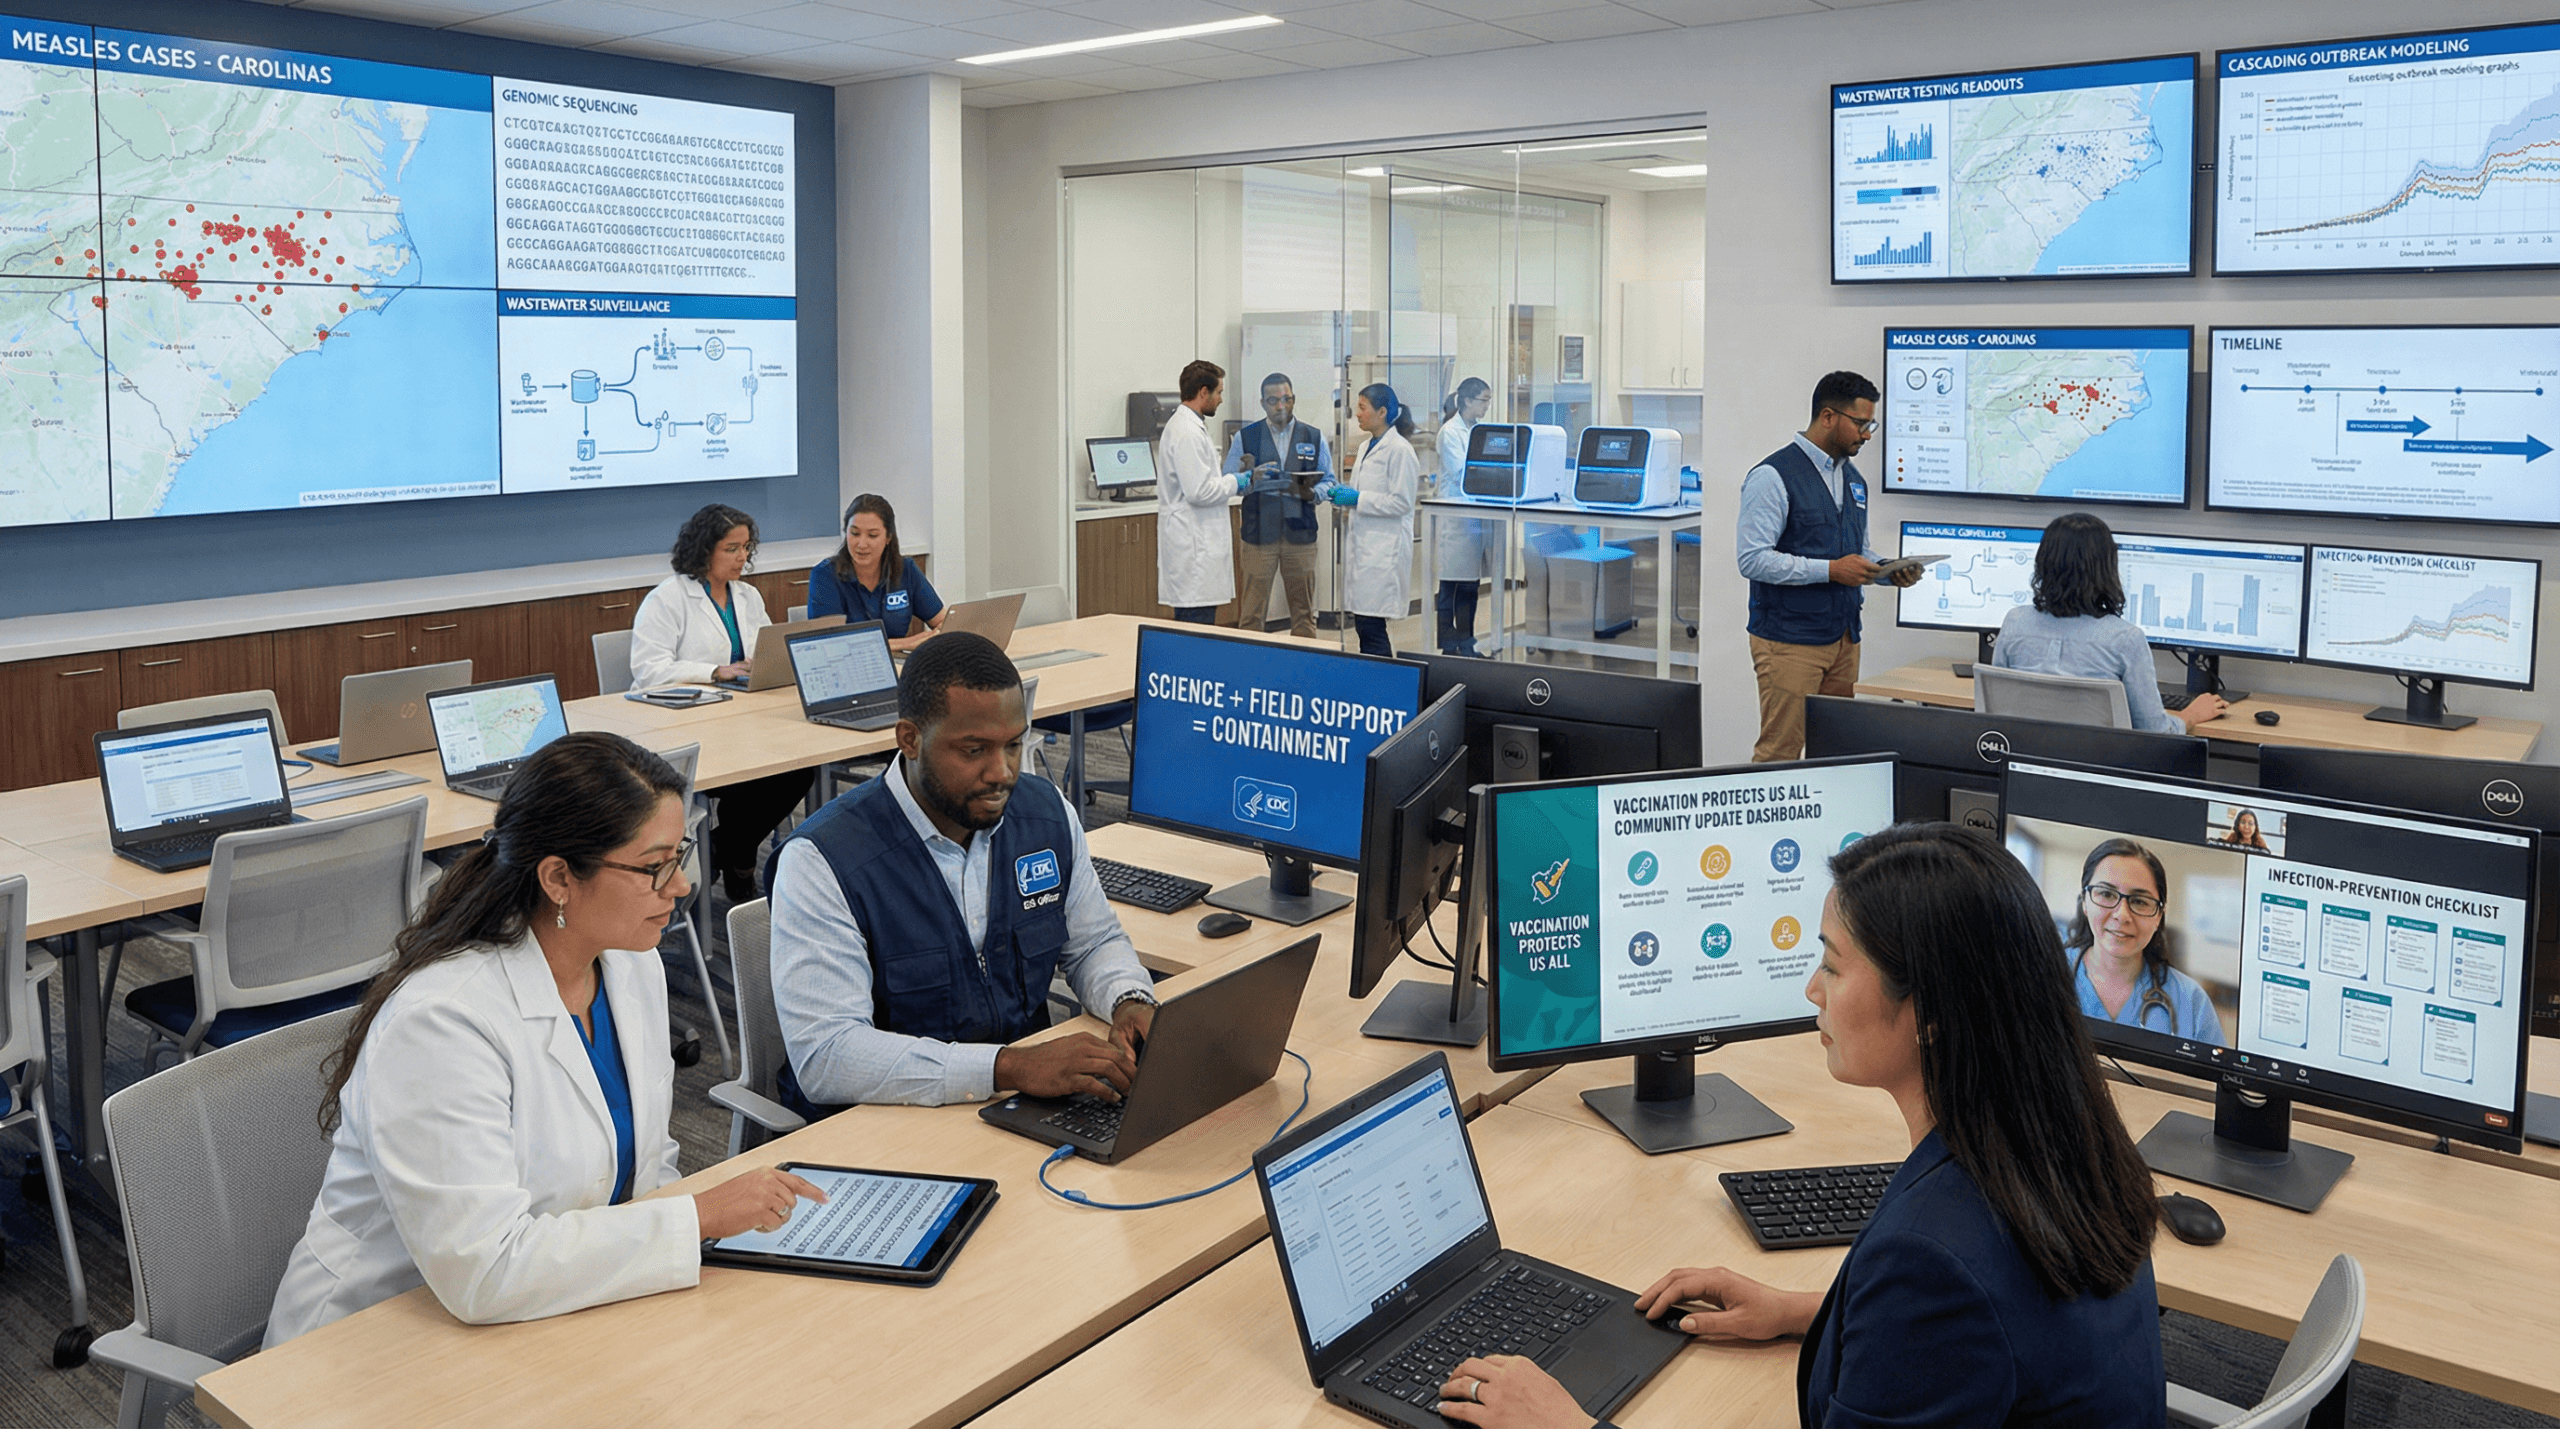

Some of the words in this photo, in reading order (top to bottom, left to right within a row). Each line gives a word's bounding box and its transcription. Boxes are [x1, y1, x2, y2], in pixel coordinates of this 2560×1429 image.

[12, 29, 121, 61] MEASLES
[127, 43, 197, 70] CASES
[217, 54, 333, 85] CAROLINAS
[2228, 52, 2307, 72] CASCADING
[2310, 45, 2388, 66] OUTBREAK
[2391, 38, 2470, 57] MODELING
[502, 88, 560, 107] GENOMIC
[563, 96, 639, 116] SEQUENCING
[1839, 87, 1911, 104] WASTEWATER
[1912, 82, 1959, 100] TESTING
[1962, 77, 2024, 94] READOUTS
[506, 297, 588, 312] WASTEWATER
[589, 299, 671, 313] SURVEILLANCE
[2221, 337, 2283, 351] TIMELINE
[1147, 671, 1226, 709] SCIENCE
[1229, 690, 1244, 708] +
[1249, 687, 1304, 722] FIELD
[1309, 696, 1408, 736] SUPPORT
[1192, 718, 1207, 734] =
[1212, 715, 1351, 765] CONTAINMENT
[1266, 796, 1290, 814] CDC
[1613, 792, 1699, 815] VACCINATION
[1701, 787, 1766, 808] PROTECTS
[1768, 785, 1786, 803] US
[1788, 784, 1810, 801] ALL
[2486, 791, 2520, 804] DELL
[1614, 814, 1692, 836] COMMUNITY
[1695, 809, 1743, 830] UPDATE
[1746, 803, 1822, 825] DASHBOARD
[2268, 868, 2421, 906] INFECTION-PREVENTION
[2425, 894, 2500, 919] CHECKLIST
[1509, 914, 1590, 937] VACCINATION
[1518, 934, 1582, 955] PROTECTS
[1529, 956, 1547, 972] US
[1547, 954, 1571, 970] ALL
